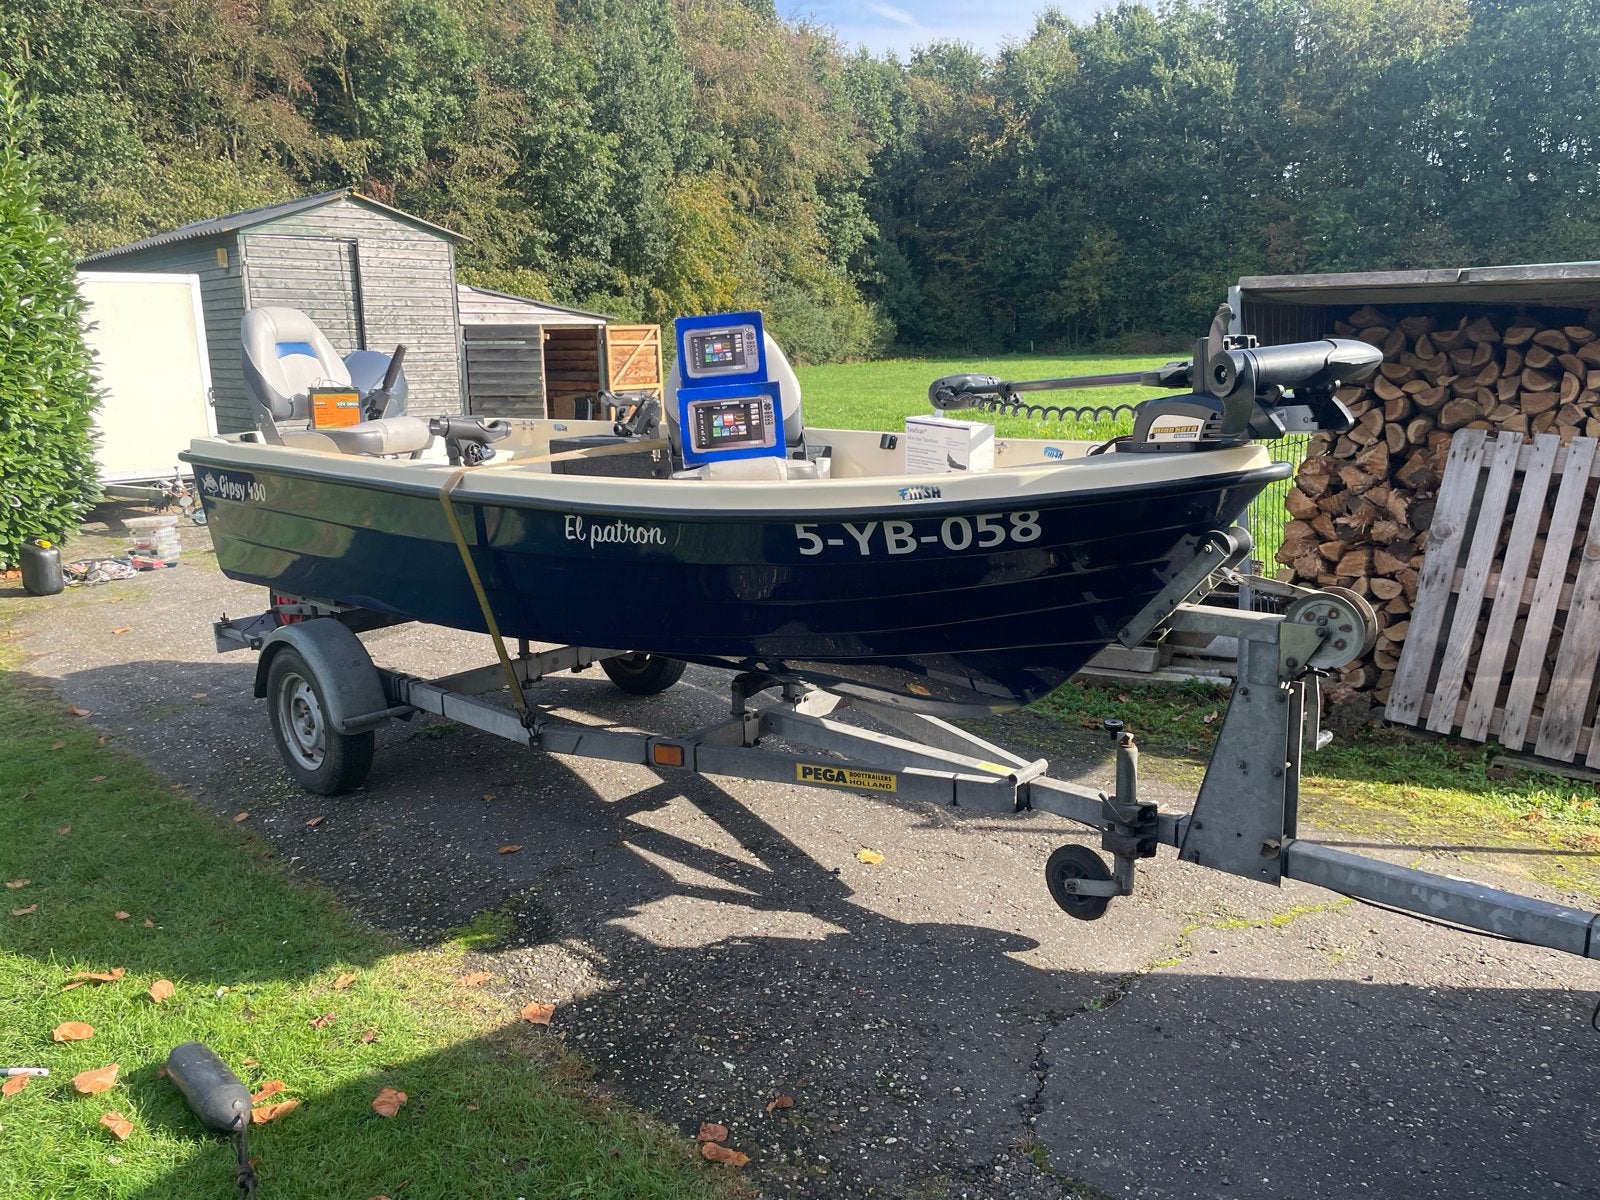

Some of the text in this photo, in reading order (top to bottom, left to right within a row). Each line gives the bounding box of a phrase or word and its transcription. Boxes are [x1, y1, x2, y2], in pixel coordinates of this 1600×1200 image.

[219, 475, 246, 502] Gipsy
[564, 514, 667, 550] El patron
[794, 509, 1043, 557] 5-YB-058
[801, 765, 892, 785] PEGA BOOTTRAILERS
[849, 779, 892, 790] HOLLAND
